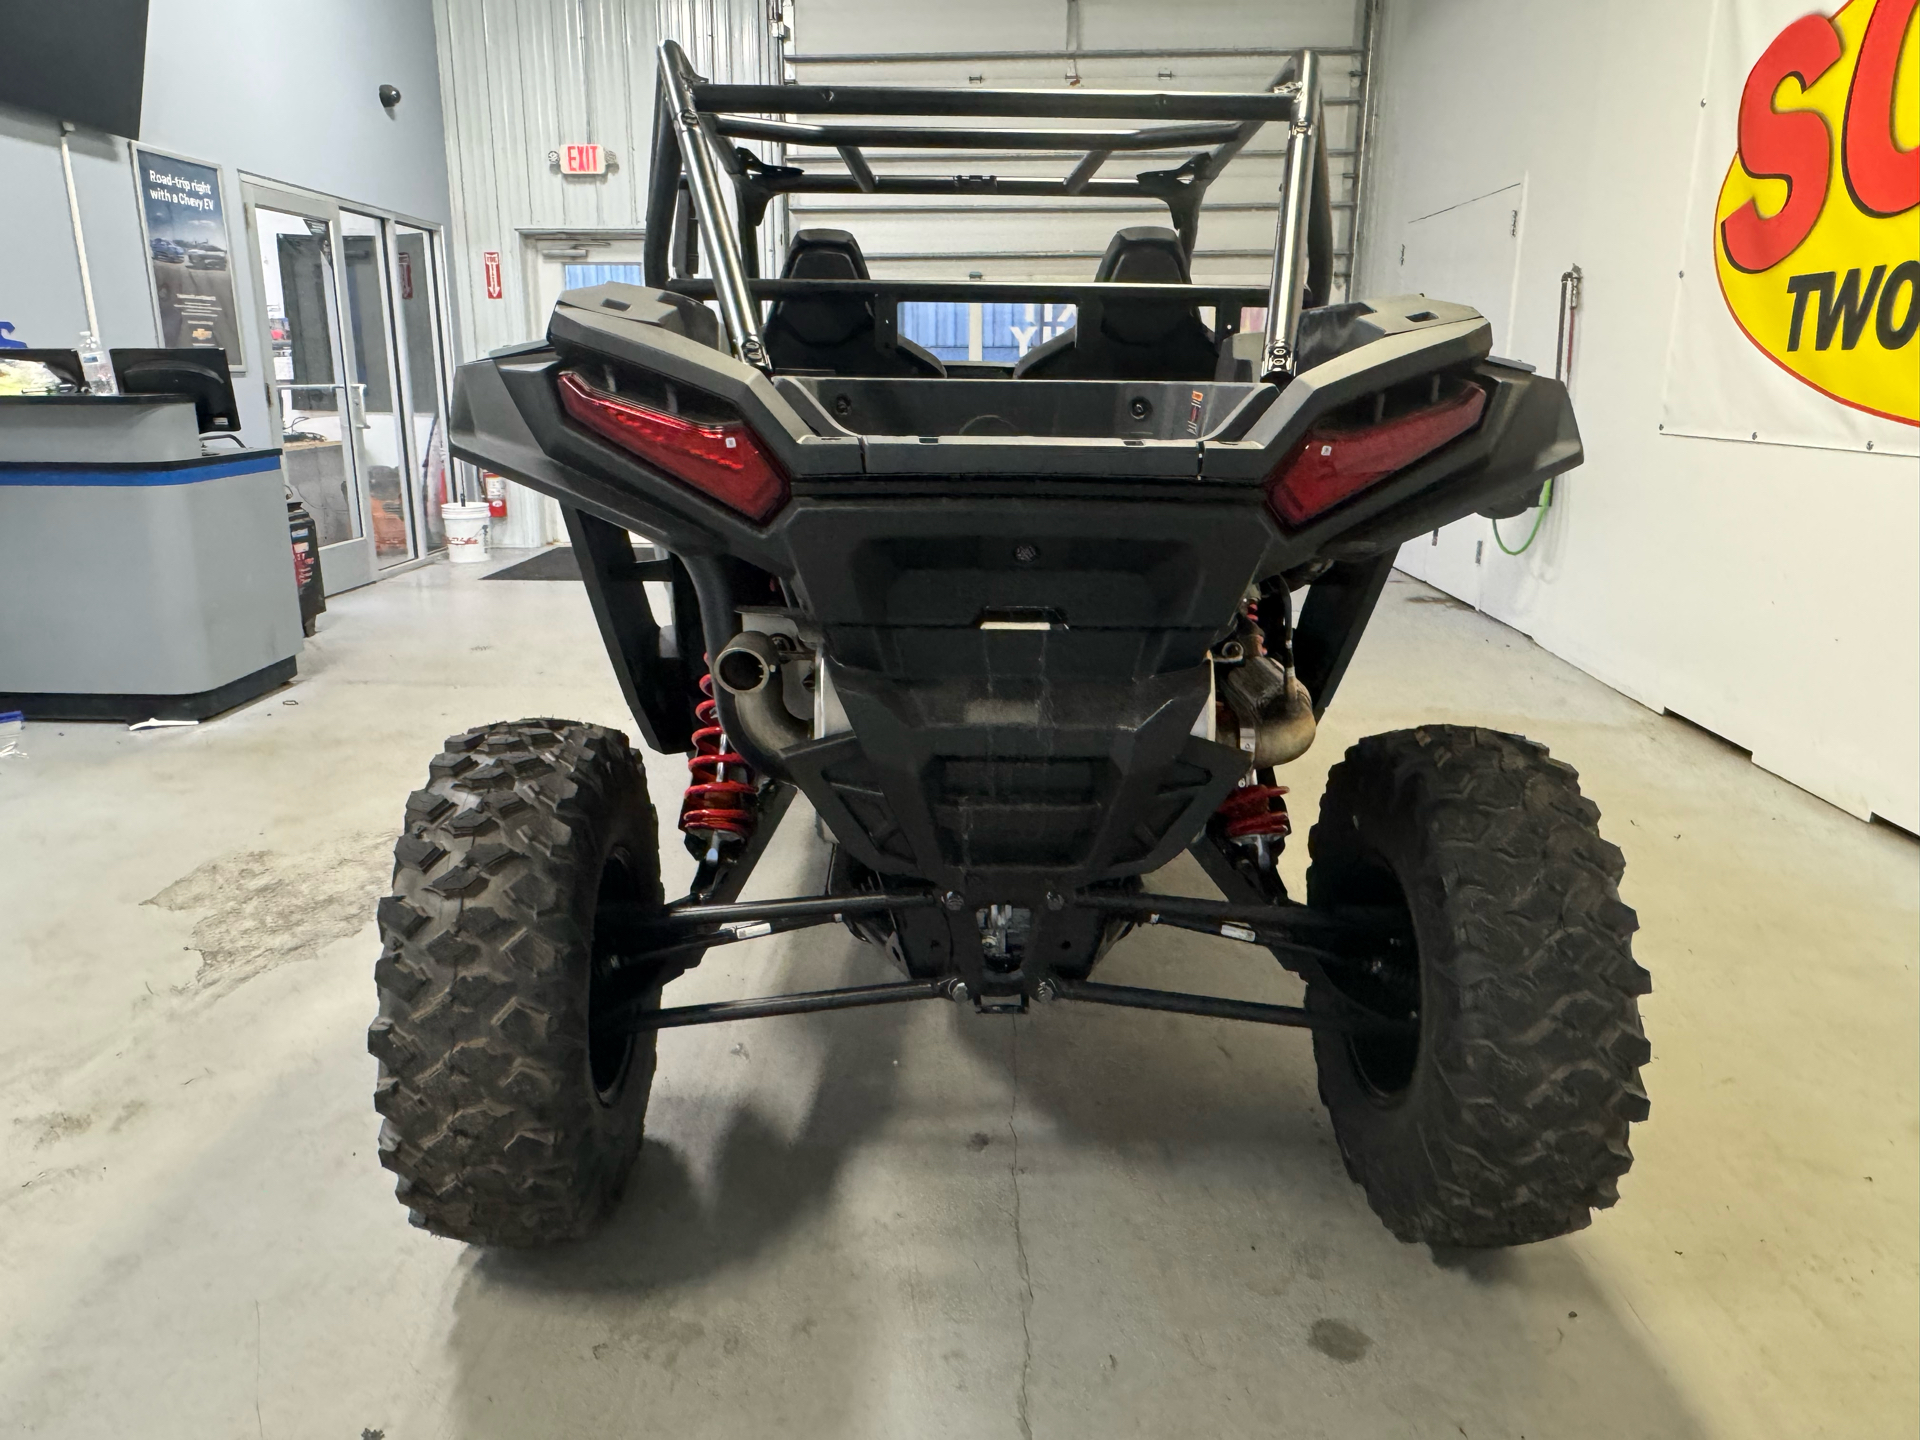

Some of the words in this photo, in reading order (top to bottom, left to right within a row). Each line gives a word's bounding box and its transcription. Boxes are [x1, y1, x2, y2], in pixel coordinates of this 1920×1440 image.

[567, 146, 598, 172] EXIT
[149, 169, 191, 192] Road-trip
[191, 179, 212, 195] right
[149, 188, 172, 203] with
[172, 193, 179, 204] a
[178, 192, 203, 211] Chevy
[203, 198, 214, 211] EV
[1787, 260, 1920, 352] TWO
